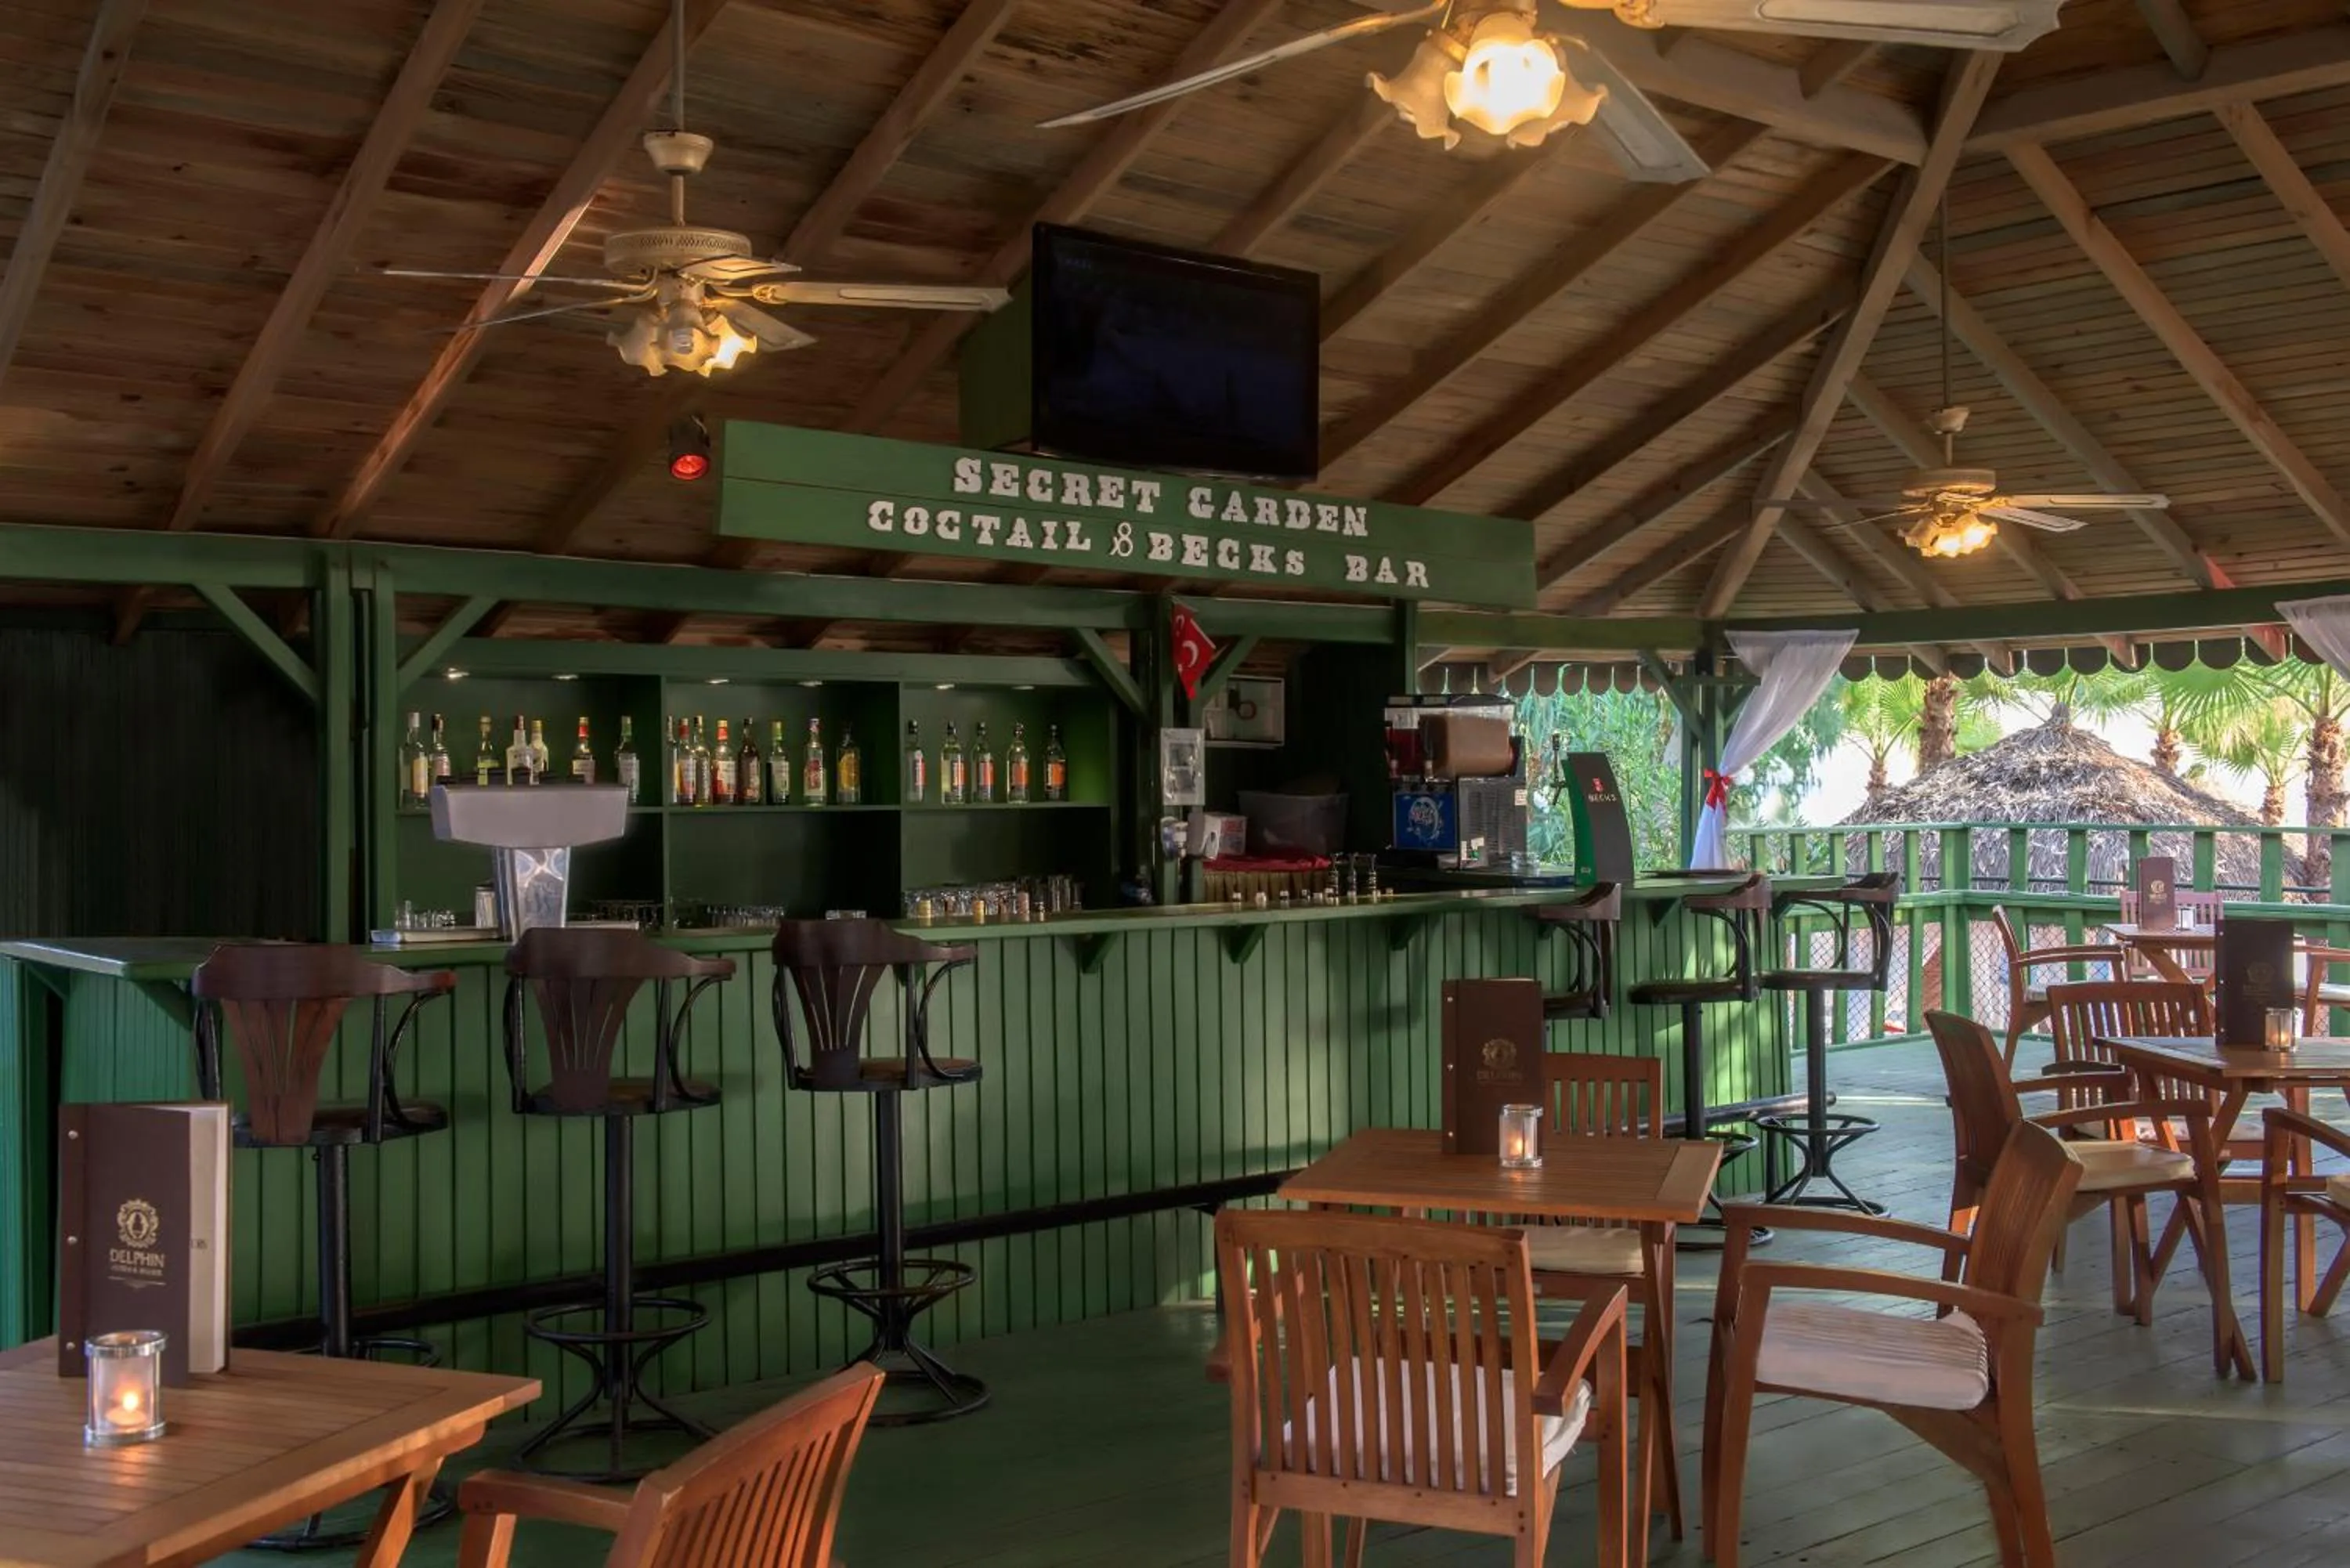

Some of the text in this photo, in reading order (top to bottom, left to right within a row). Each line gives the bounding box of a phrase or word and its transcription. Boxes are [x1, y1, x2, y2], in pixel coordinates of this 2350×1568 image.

[953, 457, 1368, 537] SECRET GARDEN
[868, 500, 1430, 588] COCTAIL & BECKS BAR
[110, 1248, 165, 1268] DELPHIN
